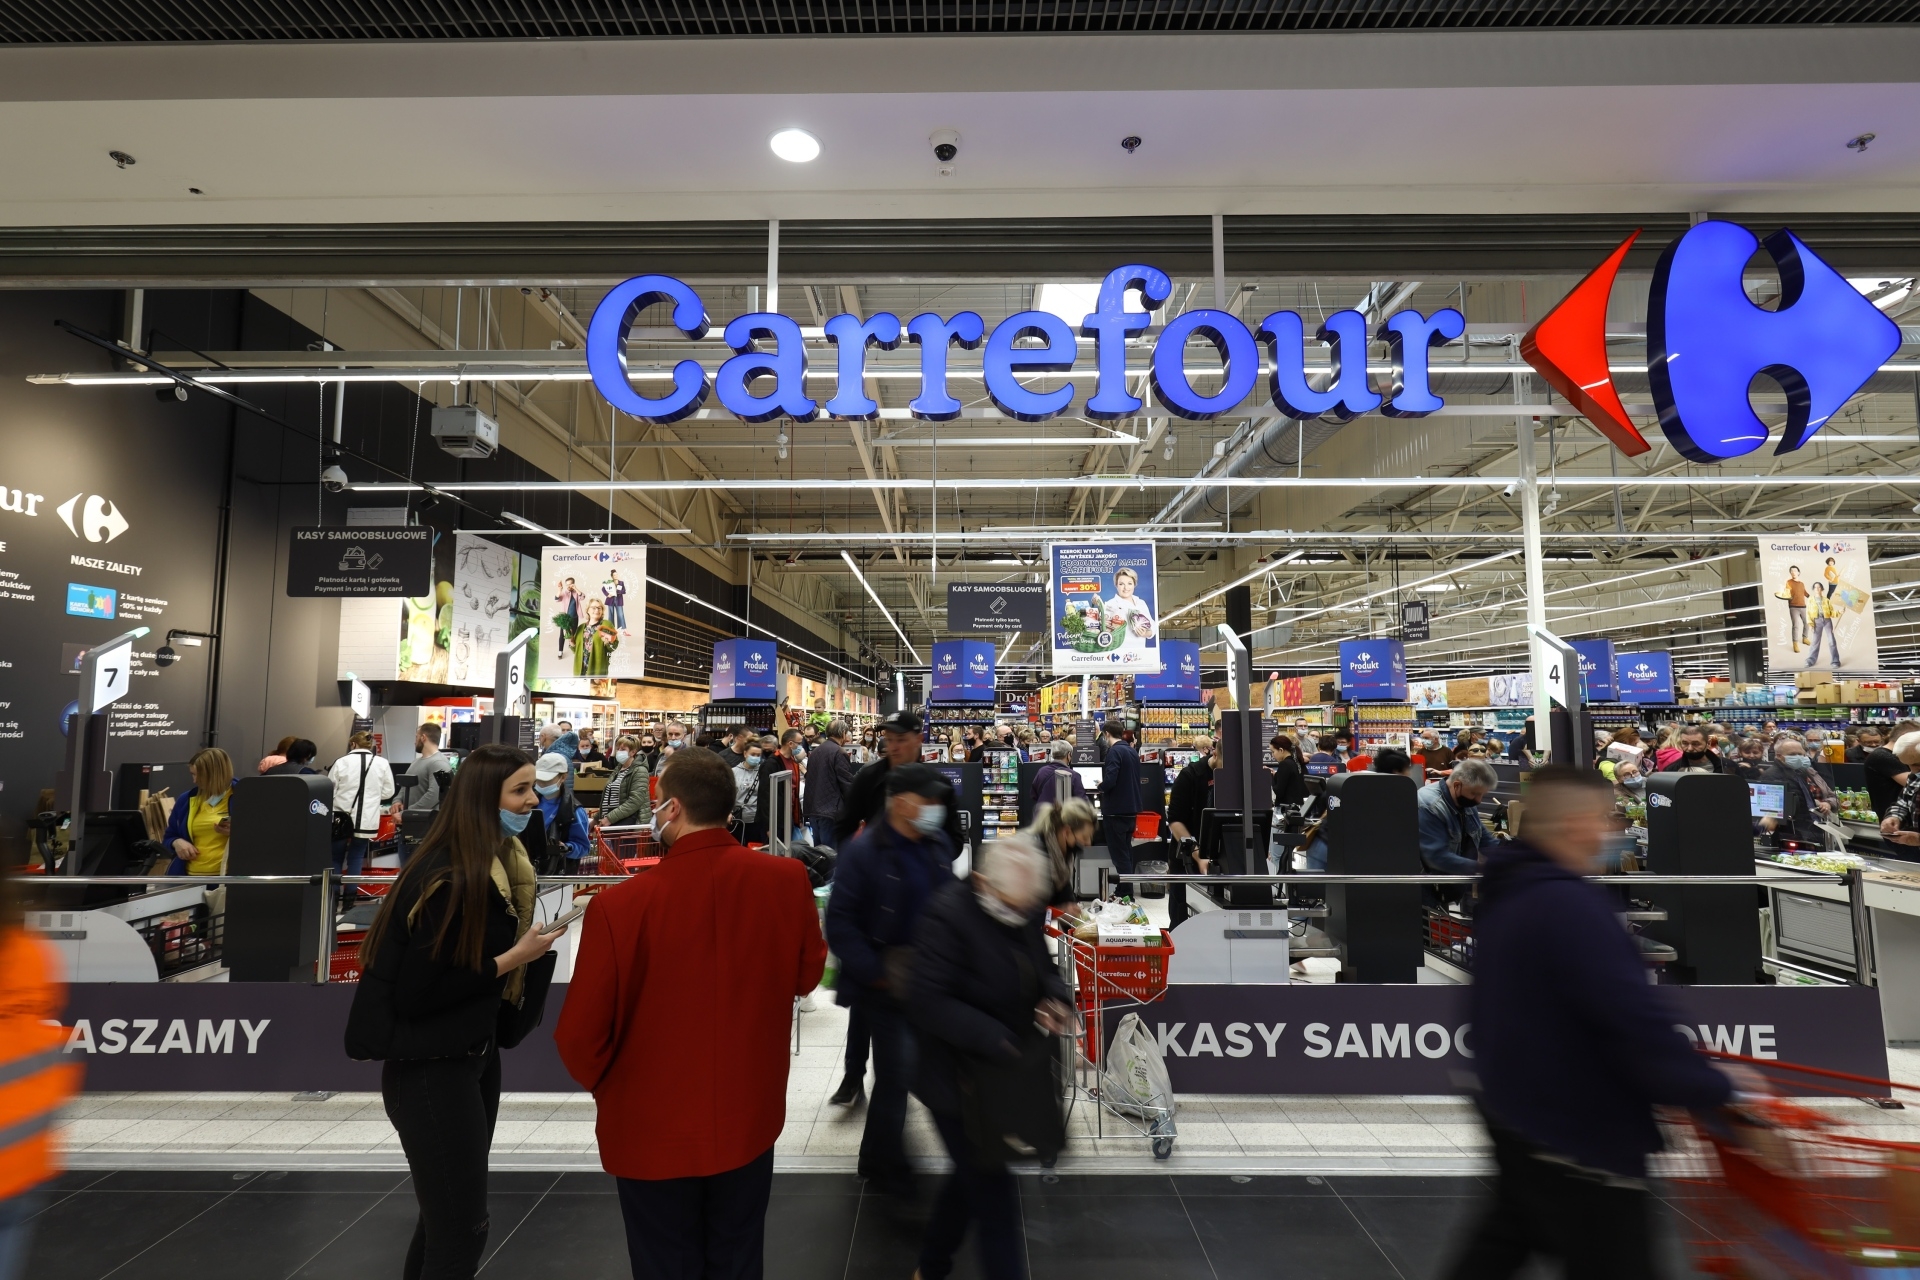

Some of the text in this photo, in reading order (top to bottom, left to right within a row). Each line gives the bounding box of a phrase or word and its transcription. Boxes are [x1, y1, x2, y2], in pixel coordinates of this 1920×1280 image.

[585, 263, 1466, 423] Carrefour
[297, 531, 427, 540] KASY SAMOOBSŁUGOWE
[1770, 543, 1811, 552] Carrefour
[552, 554, 591, 562] Carrefour
[1118, 558, 1148, 566] MARKI
[70, 555, 143, 576] NASZE ZALETY
[349, 576, 366, 584] kartą
[371, 576, 400, 584] gotówką
[11, 593, 35, 601] zwrot
[127, 594, 143, 603] kartą
[144, 597, 168, 605] seniora
[144, 606, 163, 614] każdy
[717, 661, 730, 670] Produkt
[744, 661, 768, 670] Produkt
[938, 662, 957, 671] Produkt
[970, 662, 988, 671] Produkt
[1181, 662, 1195, 672] Produkt
[1350, 661, 1379, 670] Produkt
[510, 666, 518, 684] 6
[1230, 661, 1236, 680] 5
[1549, 664, 1560, 684] 4
[1628, 671, 1657, 679] Produkt
[104, 668, 118, 687] 7
[357, 693, 362, 702] 9
[519, 694, 526, 705] 10
[6, 721, 19, 729] się
[1157, 1022, 1287, 1058] KASY
